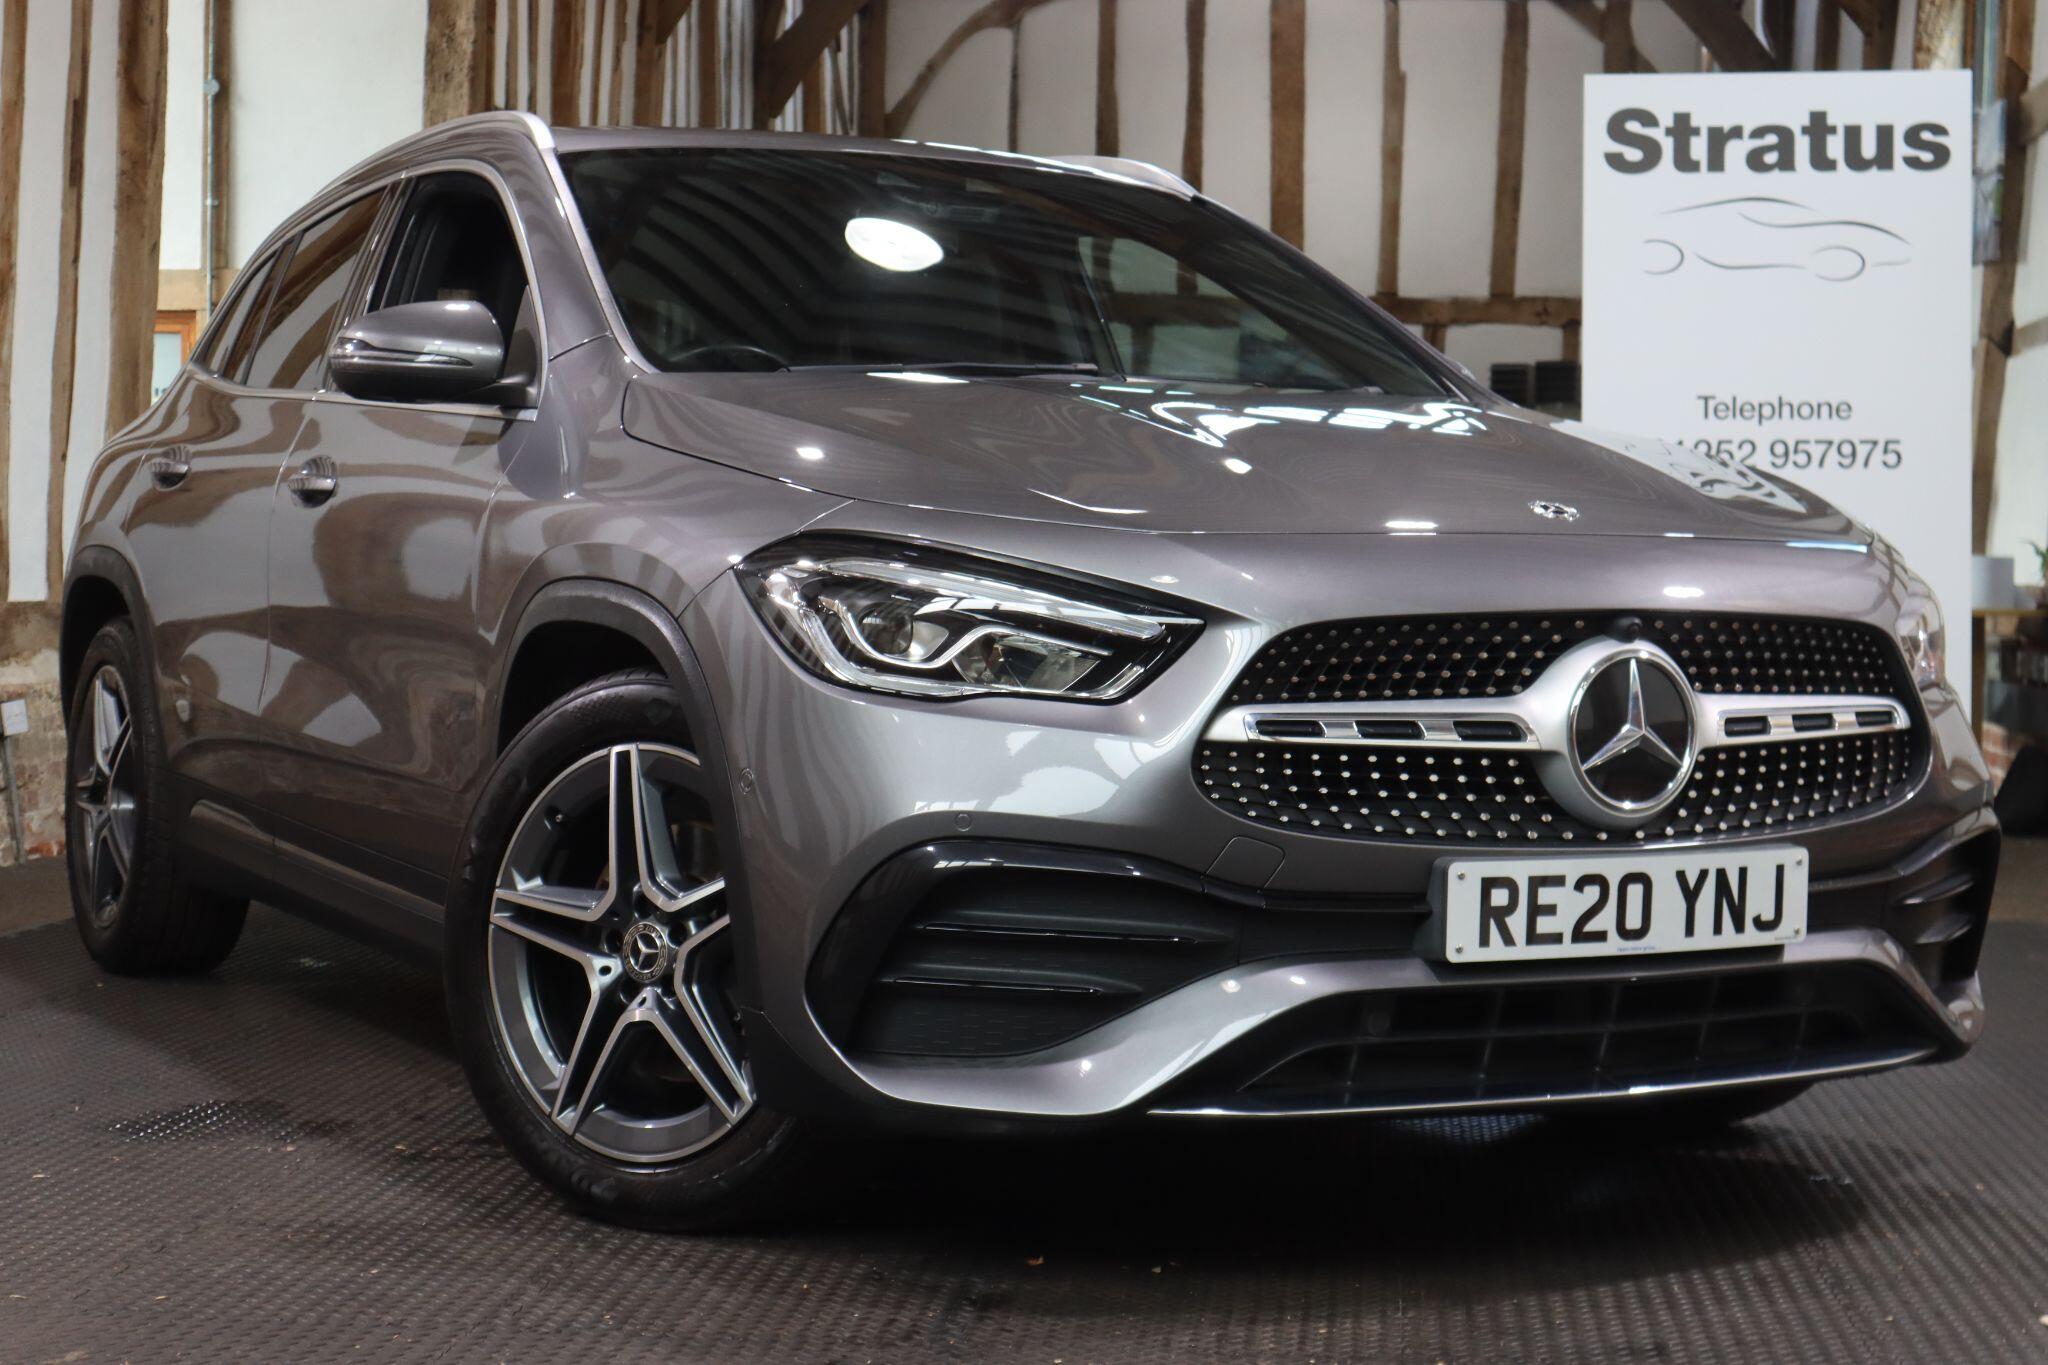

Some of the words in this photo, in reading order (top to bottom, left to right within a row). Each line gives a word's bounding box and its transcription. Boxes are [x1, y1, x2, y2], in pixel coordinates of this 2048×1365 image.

[1604, 107, 1951, 175] Stratus
[1697, 395, 1853, 426] Telephone
[1768, 439, 1903, 469] 957975
[1479, 871, 1654, 948] RE20
[1675, 863, 1785, 938] YNJ
